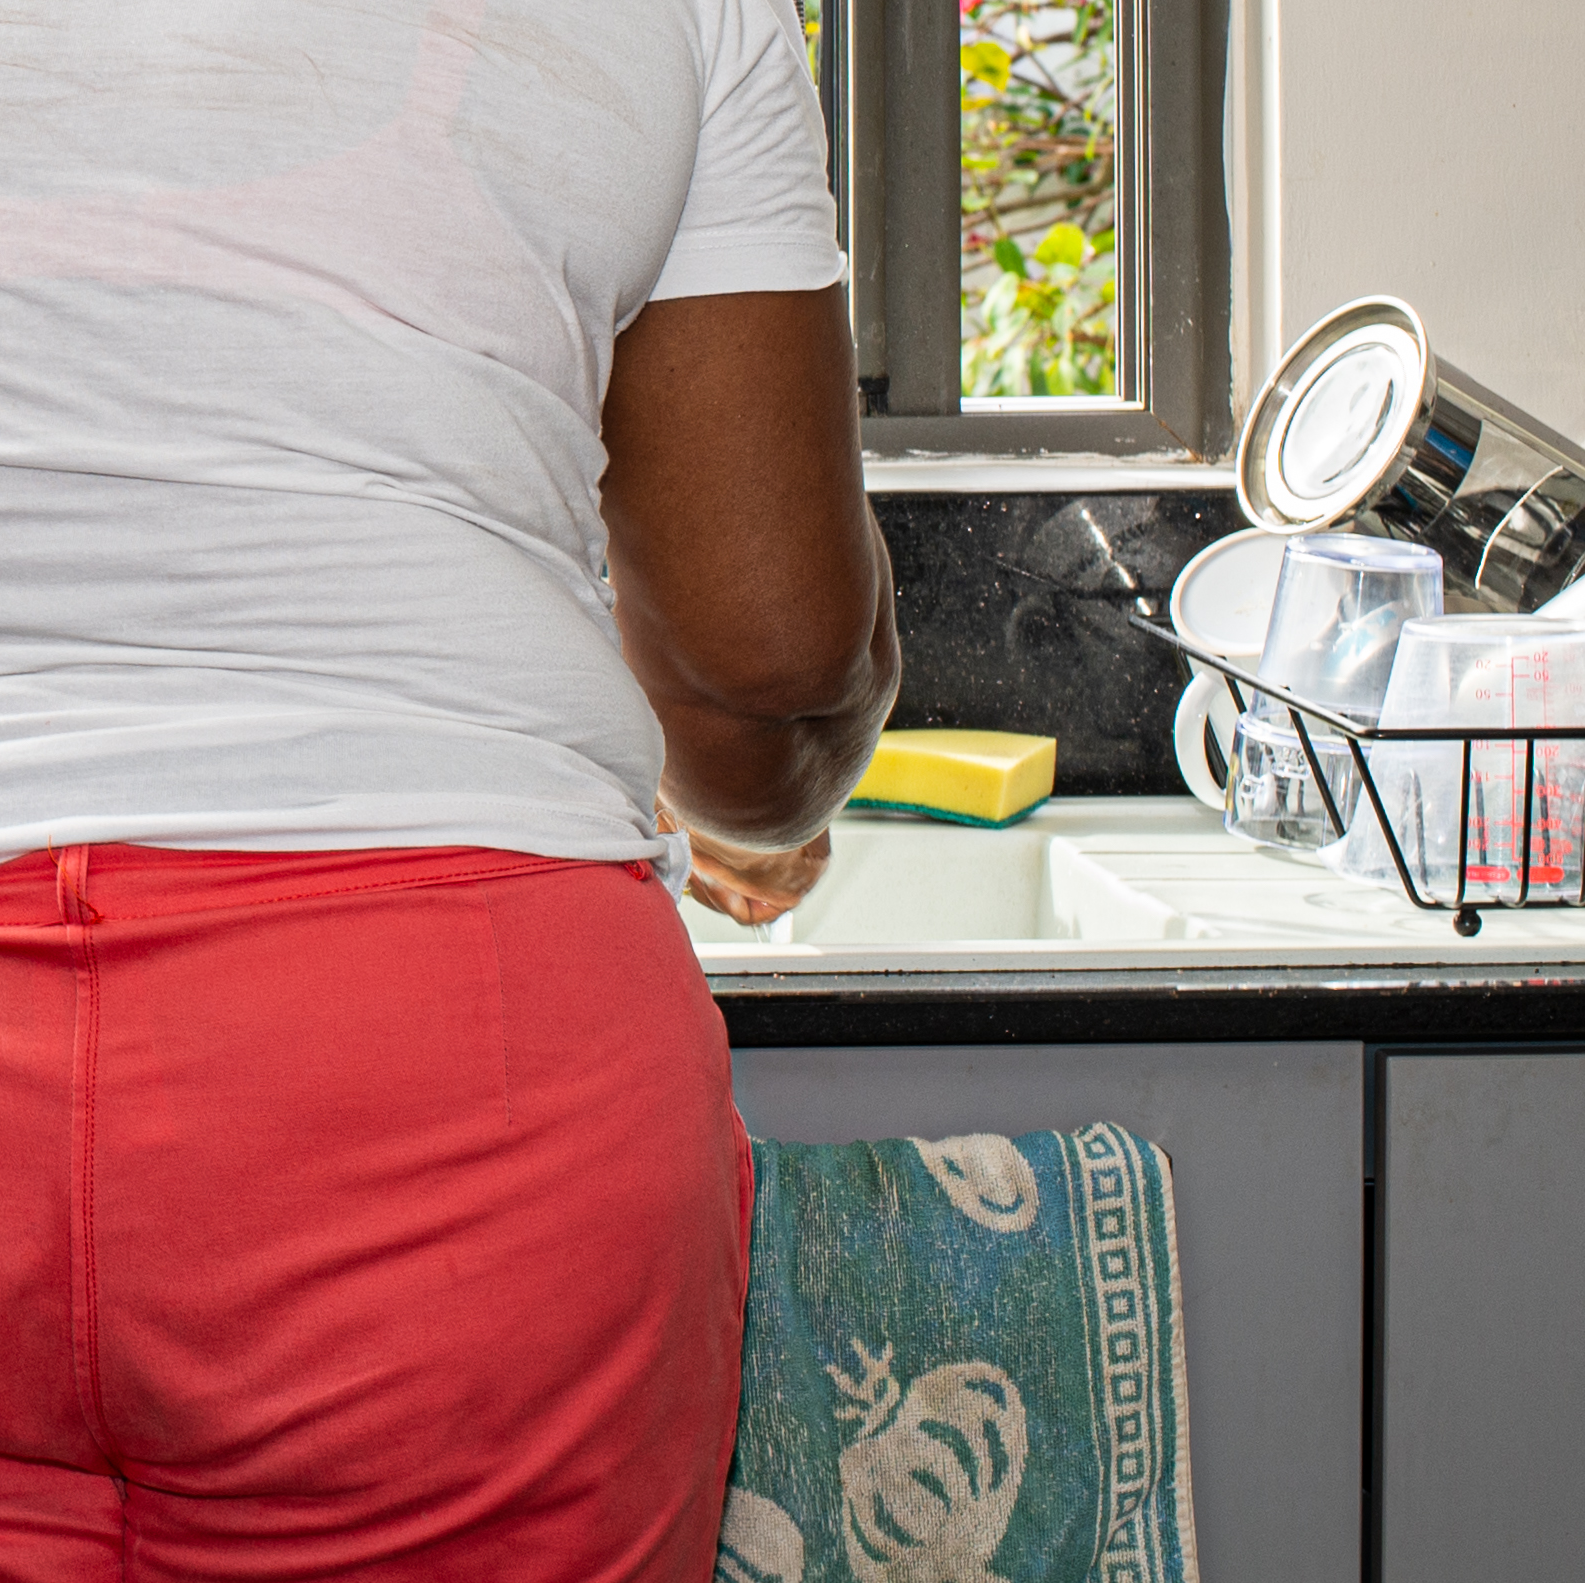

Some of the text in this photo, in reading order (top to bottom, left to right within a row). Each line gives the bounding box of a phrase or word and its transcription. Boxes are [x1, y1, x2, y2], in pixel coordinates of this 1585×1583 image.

[1533, 651, 1549, 663] 20
[1475, 659, 1491, 670] 20
[1533, 670, 1549, 681] 50
[1475, 689, 1491, 700] 50
[1535, 745, 1560, 758] 200
